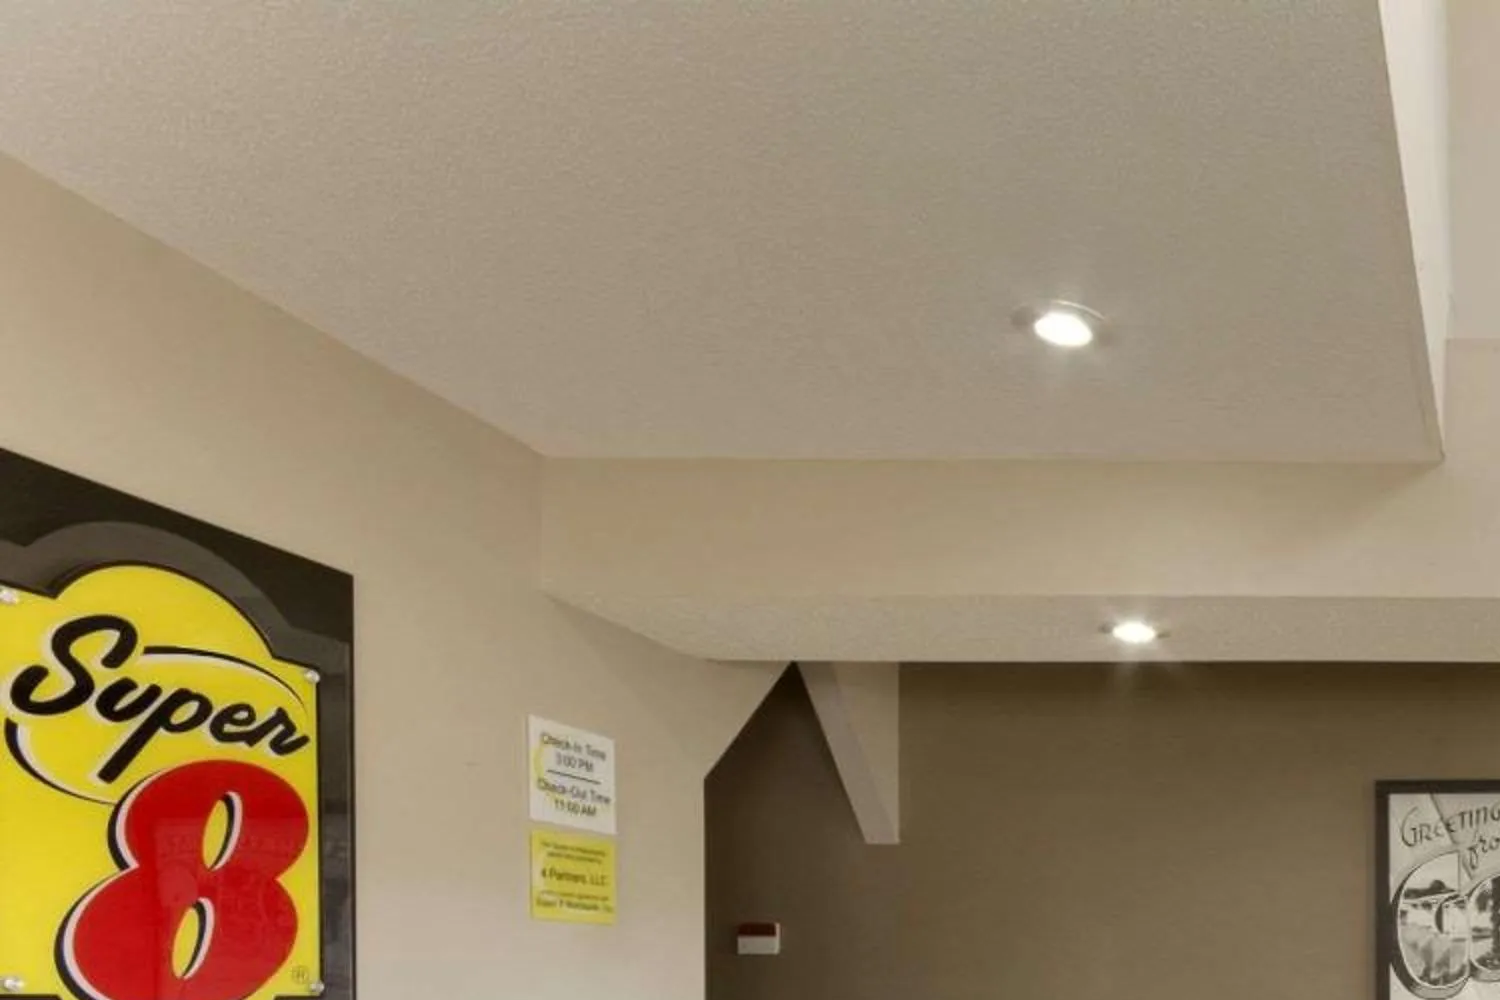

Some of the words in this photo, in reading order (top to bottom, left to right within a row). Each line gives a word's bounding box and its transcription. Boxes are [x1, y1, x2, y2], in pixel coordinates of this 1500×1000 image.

[10, 613, 310, 783] Super
[585, 744, 607, 761] Time
[578, 758, 594, 772] PM
[590, 789, 611, 805] Time
[581, 804, 597, 817] AM
